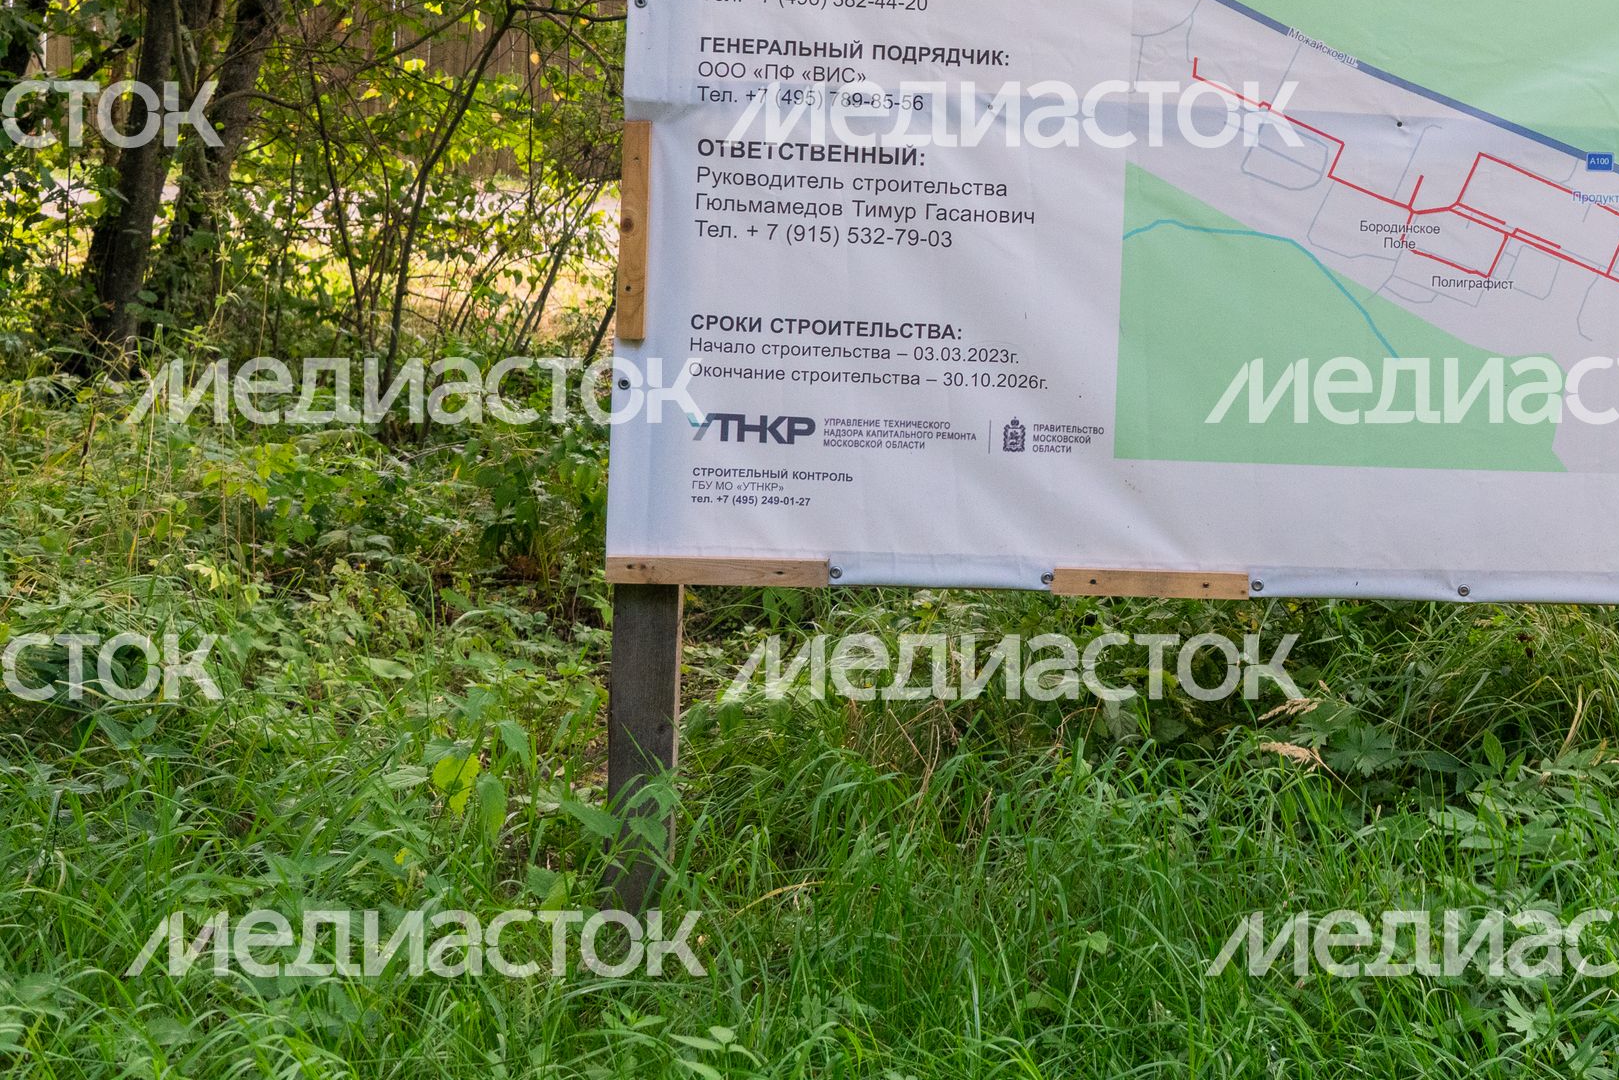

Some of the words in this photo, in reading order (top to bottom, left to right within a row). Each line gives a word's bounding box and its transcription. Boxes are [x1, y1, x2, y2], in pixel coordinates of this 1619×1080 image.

[701, 37, 862, 59] ГЕНЕРАЛЬНЫЙ
[873, 45, 1009, 67] ПОДРЯДЧИК:
[698, 61, 745, 78] ООО
[754, 64, 794, 80] «ПФ
[802, 66, 865, 83] «ВИС»
[697, 86, 737, 102] Тел.
[746, 88, 768, 102] +7
[776, 89, 822, 107] (495)
[828, 91, 923, 111] 789-85-56
[698, 139, 924, 166] ОТВЕТСТВЕННЫЙ:
[697, 166, 843, 190] Руководитель
[853, 178, 1007, 196] строительства
[696, 193, 842, 218] Гюльмамедов
[852, 200, 916, 223] Тимур
[926, 203, 1034, 224] Гасанович
[695, 220, 737, 238] Тел.
[767, 224, 778, 240] 7
[787, 224, 839, 247] (915)
[848, 227, 952, 247] 532-79-03
[1360, 220, 1440, 234] Бородинское
[1384, 234, 1415, 249] Поле
[1432, 276, 1513, 291] Полиграфист
[691, 314, 761, 332] СРОКИ
[771, 318, 961, 339] СТРОИТЕЛЬСТВА:
[690, 337, 755, 354] Начало
[762, 344, 890, 359] строительства
[914, 347, 1018, 363] 03.03.2023г.
[688, 364, 785, 380] Окончание
[792, 370, 919, 385] строительства
[943, 372, 1047, 389] 30.10.2026г.
[690, 413, 816, 444] УТНКР
[825, 418, 880, 427] УПРАВЛЕНИЕ
[884, 420, 950, 429] ТЕХНИЧЕСКОГО
[1034, 424, 1104, 434] ПРАВИТЕЛЬСТВО
[824, 429, 863, 438] НАДЗОРА
[866, 430, 933, 439] КАПИТАЛЬНОГО
[936, 432, 976, 440] РЕМОНТА
[1033, 435, 1091, 444] МОСКОВСКОЙ
[823, 439, 882, 448] МОСКОВСКОЙ
[886, 441, 925, 449] ОБЛАСТИ
[1033, 445, 1071, 453] ОБЛАСТИ
[693, 468, 788, 479] СТРОИТЕЛЬНЫЙ
[793, 471, 853, 481] КОНТРОЛЬ
[692, 481, 712, 489] ГБУ
[716, 481, 733, 490] МО
[737, 482, 784, 491] «УТНКР»
[717, 495, 729, 503] +7
[732, 495, 757, 506] (495)
[761, 496, 810, 506] 249-01-27
